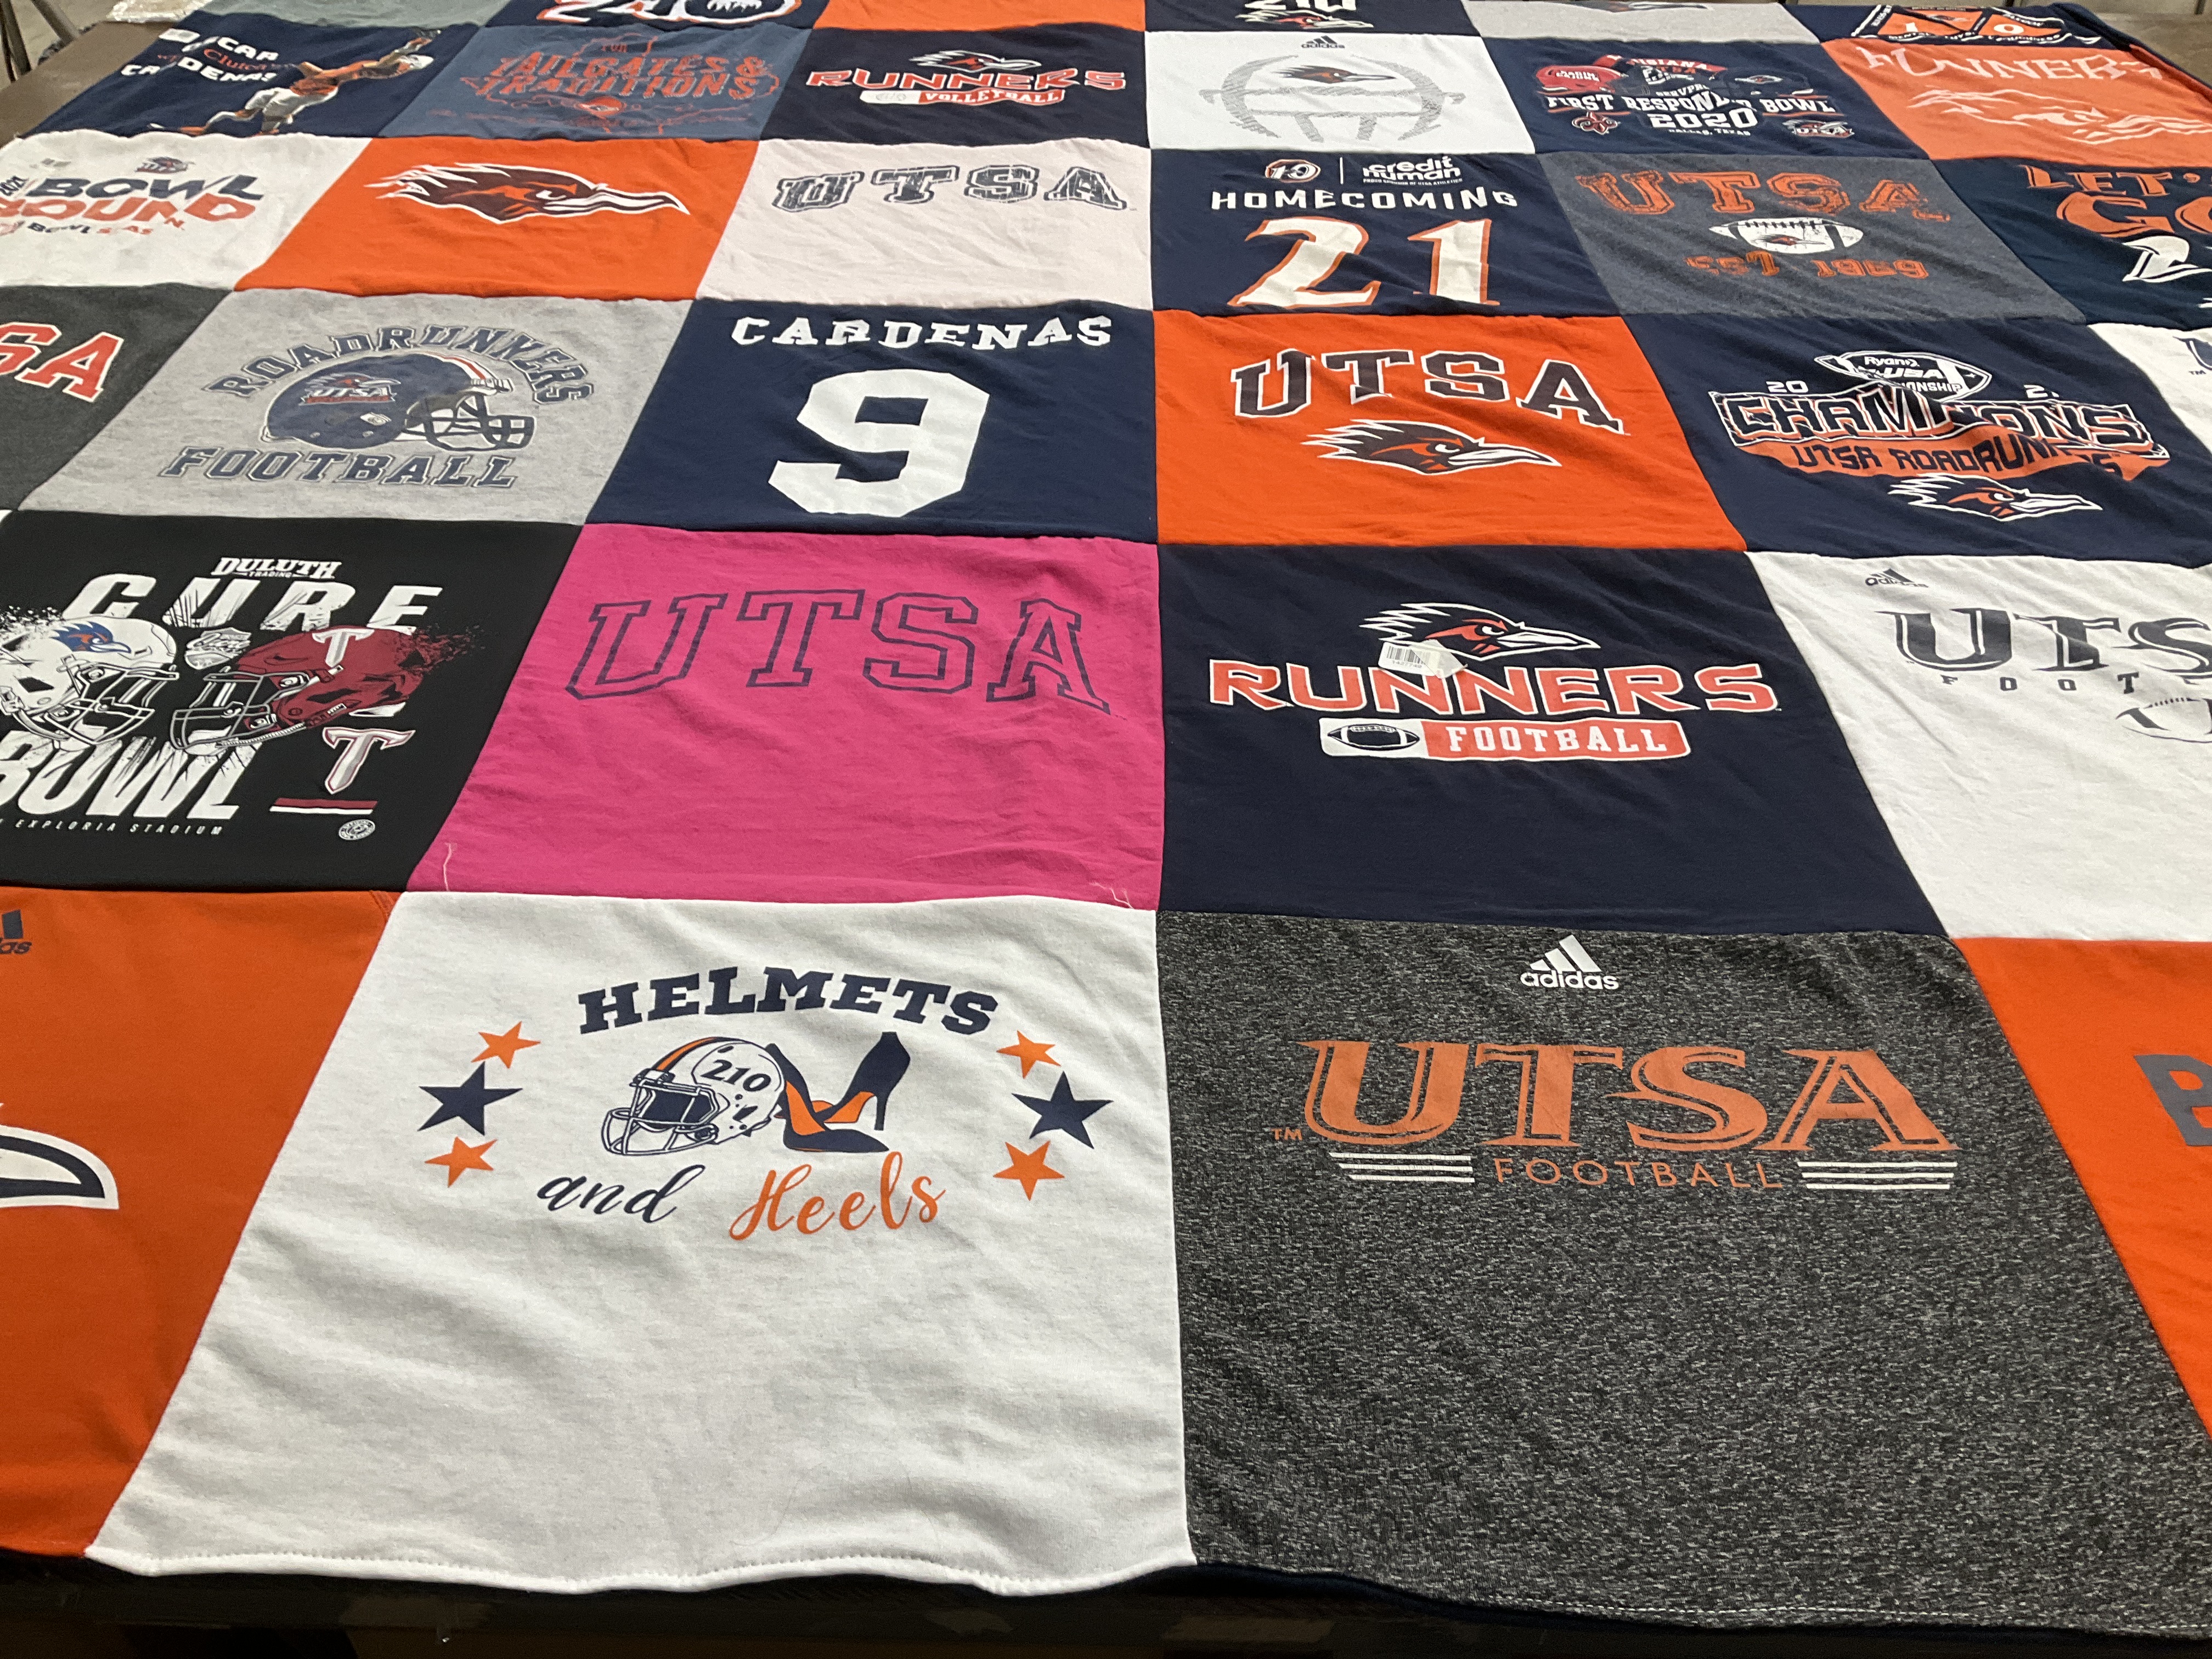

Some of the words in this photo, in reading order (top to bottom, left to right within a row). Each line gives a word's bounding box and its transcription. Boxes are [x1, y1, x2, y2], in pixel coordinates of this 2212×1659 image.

[121, 56, 276, 82] CADENA
[806, 68, 1126, 90] RUNNERS
[476, 74, 759, 100] TRADITIONS
[924, 88, 1060, 103] VOLLEYBALL
[1544, 93, 1615, 111] FIRST
[1621, 89, 1757, 112] RESPON
[1646, 107, 1758, 129] 2020
[1363, 167, 1462, 181] human
[1369, 155, 1454, 172] credit
[2018, 164, 2212, 196] LET'
[25, 174, 264, 201] BOWL
[770, 165, 1128, 213] UTSA
[1211, 187, 1518, 211] HOMECOMING
[1575, 170, 1951, 222] UTSA
[1227, 216, 1500, 309] 21
[730, 314, 1113, 351] CARDENAS
[200, 323, 595, 404] ROADRUNNERS
[1231, 347, 1626, 435] UTSA
[1765, 380, 1809, 393] 20
[1724, 386, 2156, 452] CHAMONS
[768, 368, 991, 518] 9
[1790, 444, 1882, 470] UTSA
[1888, 433, 2124, 474] ROADRUNS
[157, 445, 521, 488] FOOTBALL
[211, 557, 342, 579] DULUTH
[62, 573, 443, 635] CURE
[565, 588, 1111, 715] UTSA
[1209, 658, 1780, 715] RUNNERS
[1449, 725, 1667, 753] FOOTBALL
[0, 727, 263, 820] BOWL
[15, 819, 116, 832] EXPLORIA
[129, 823, 222, 836] STADIUM
[0, 937, 32, 955] as
[1520, 967, 1620, 990] adidas
[578, 966, 998, 1035] HELMETS
[700, 1059, 771, 1092] 210
[1297, 1039, 1961, 1152] UTSA
[1272, 1127, 1303, 1140] TM
[1494, 1157, 1784, 1190] FOOTBALL
[537, 1163, 706, 1224] and
[729, 1152, 946, 1241] Heels
